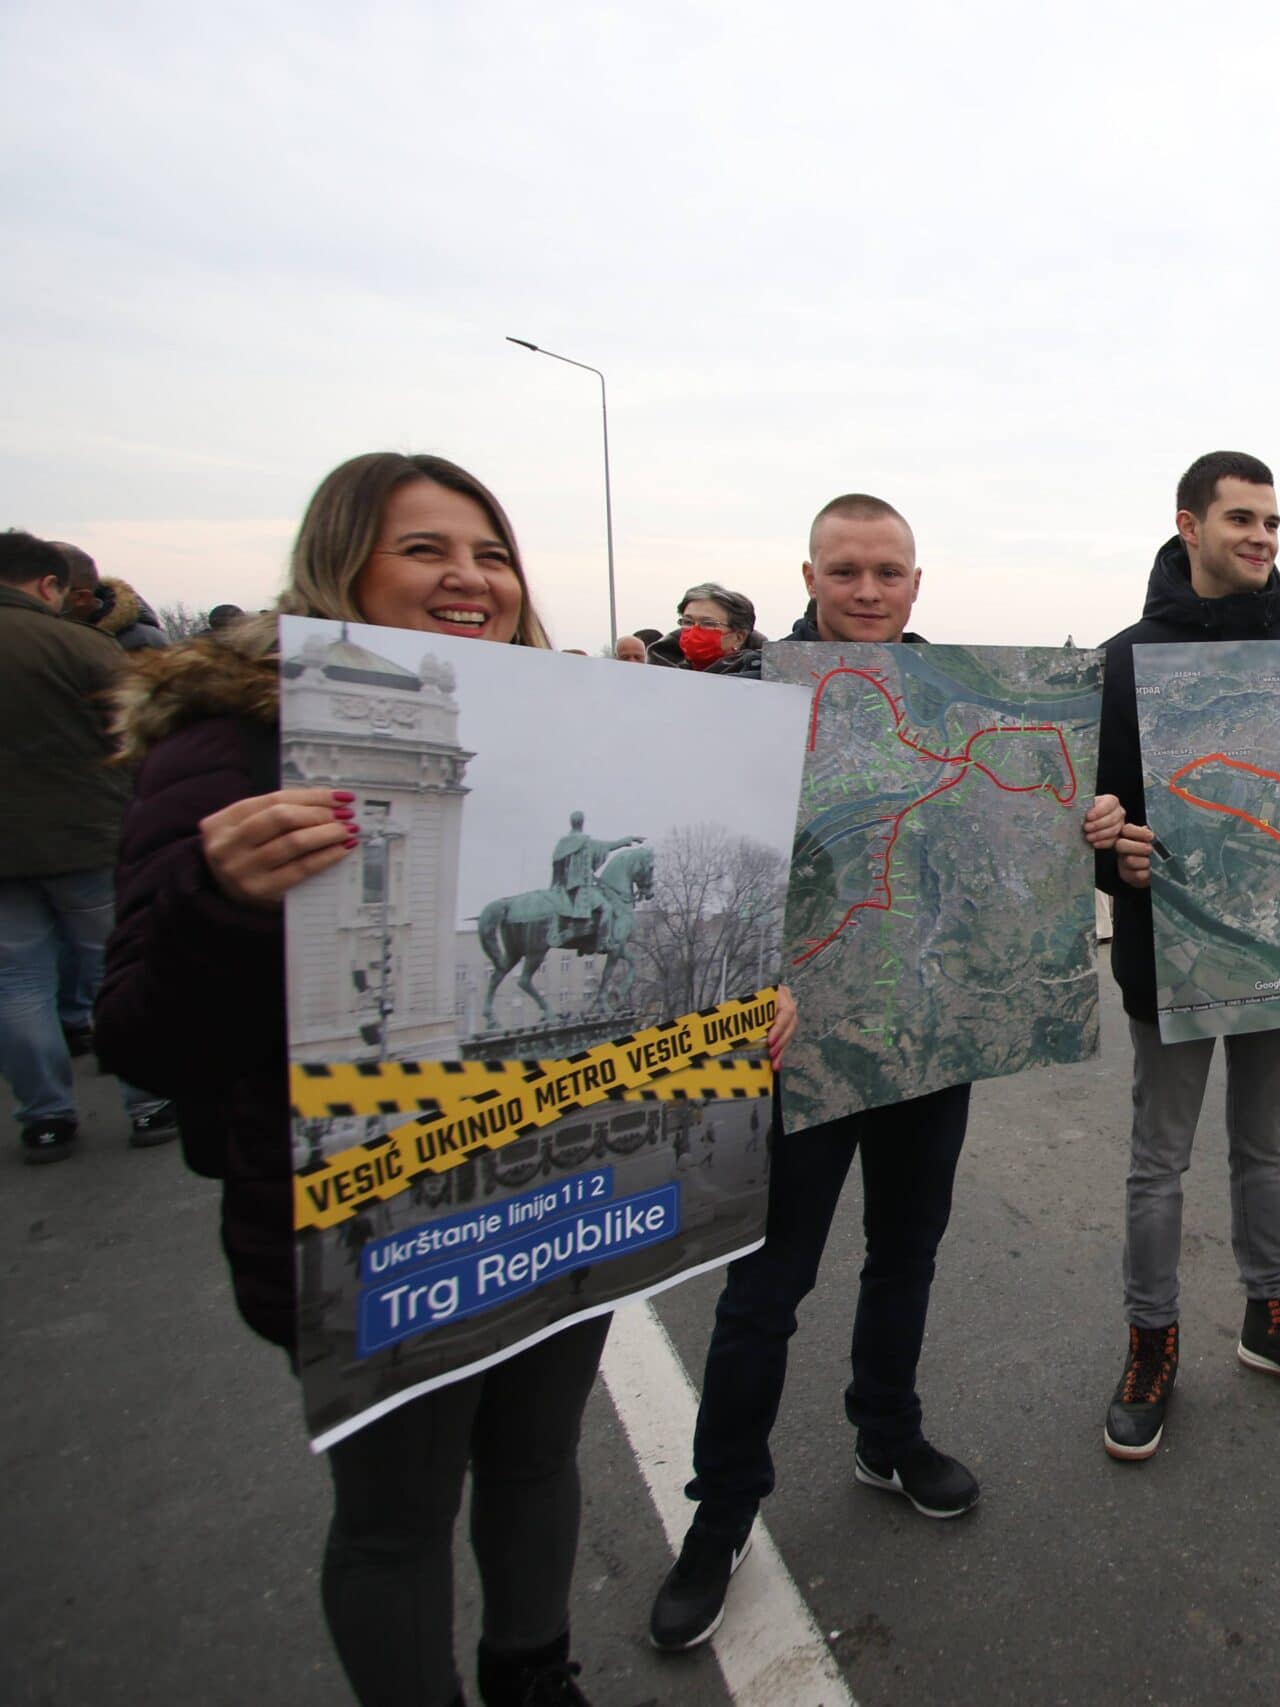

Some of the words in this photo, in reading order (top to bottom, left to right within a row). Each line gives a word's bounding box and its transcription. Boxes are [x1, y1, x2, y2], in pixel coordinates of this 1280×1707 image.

[306, 1141, 403, 1213] VESIĆ
[415, 1097, 523, 1164] UKINUO
[535, 1059, 616, 1113] METRO
[626, 1024, 693, 1072] VESIĆ
[703, 999, 776, 1046] UKINUO
[370, 1210, 502, 1274] Ukrštanje
[508, 1190, 557, 1234] linija
[561, 1187, 571, 1206] 1
[577, 1181, 584, 1201] i
[590, 1175, 606, 1197] 2
[380, 1277, 459, 1330] Trg
[477, 1202, 666, 1296] Republike
